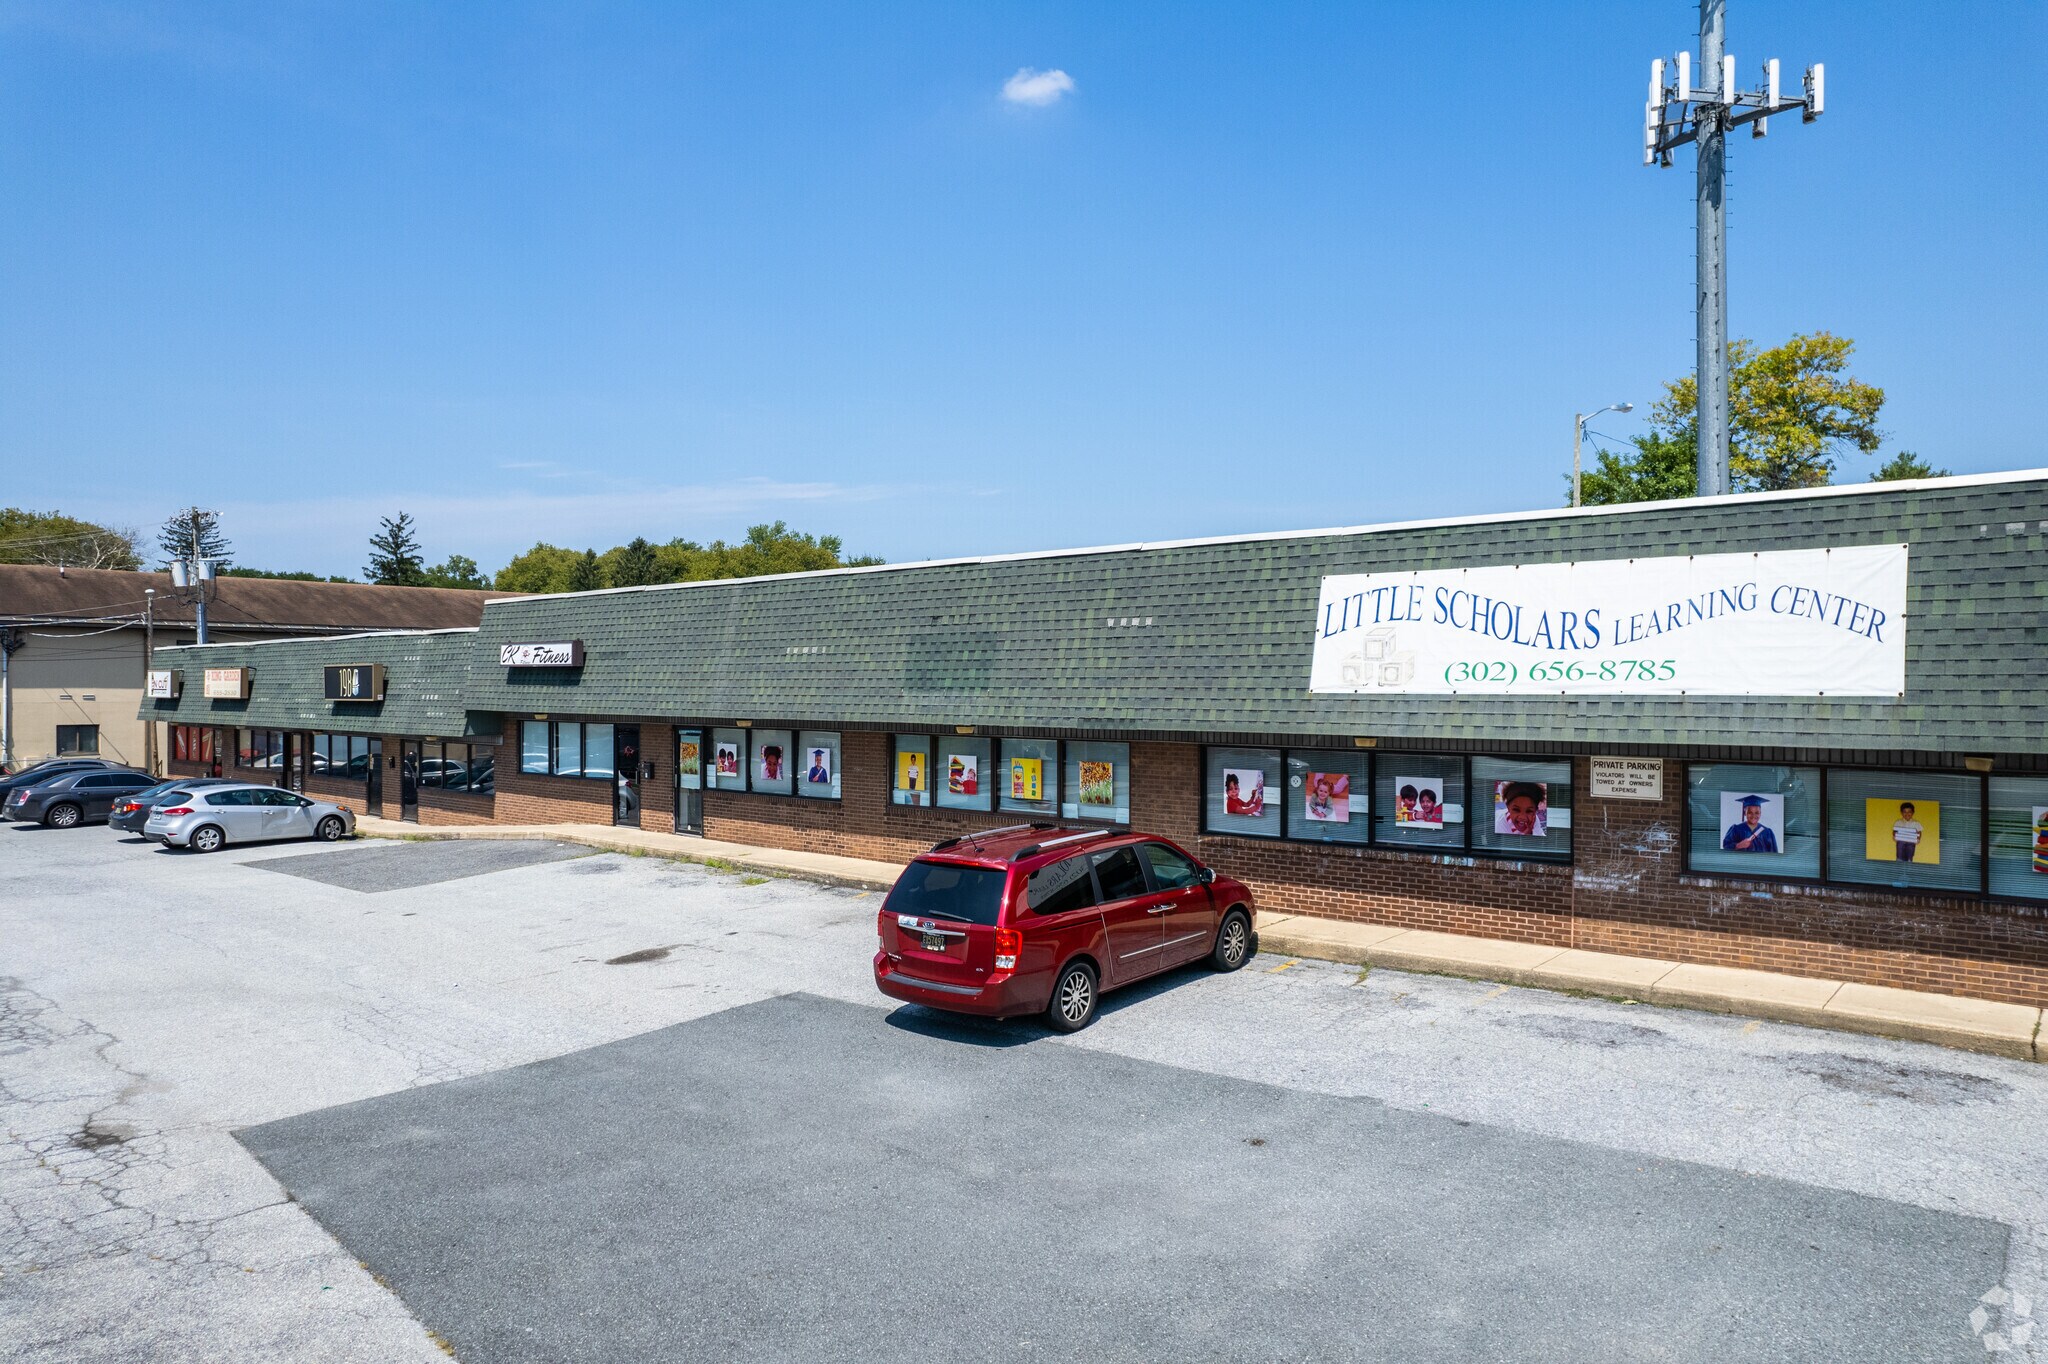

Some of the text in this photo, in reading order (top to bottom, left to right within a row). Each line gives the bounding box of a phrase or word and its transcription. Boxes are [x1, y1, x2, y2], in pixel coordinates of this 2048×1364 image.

[1321, 582, 1886, 651] LITTLE SCHOLARS LEARNING CENTER
[501, 644, 573, 664] CK Fitness
[1444, 659, 1676, 688] (302) 656-8785
[1593, 760, 1661, 771] PRIVATE PARKING
